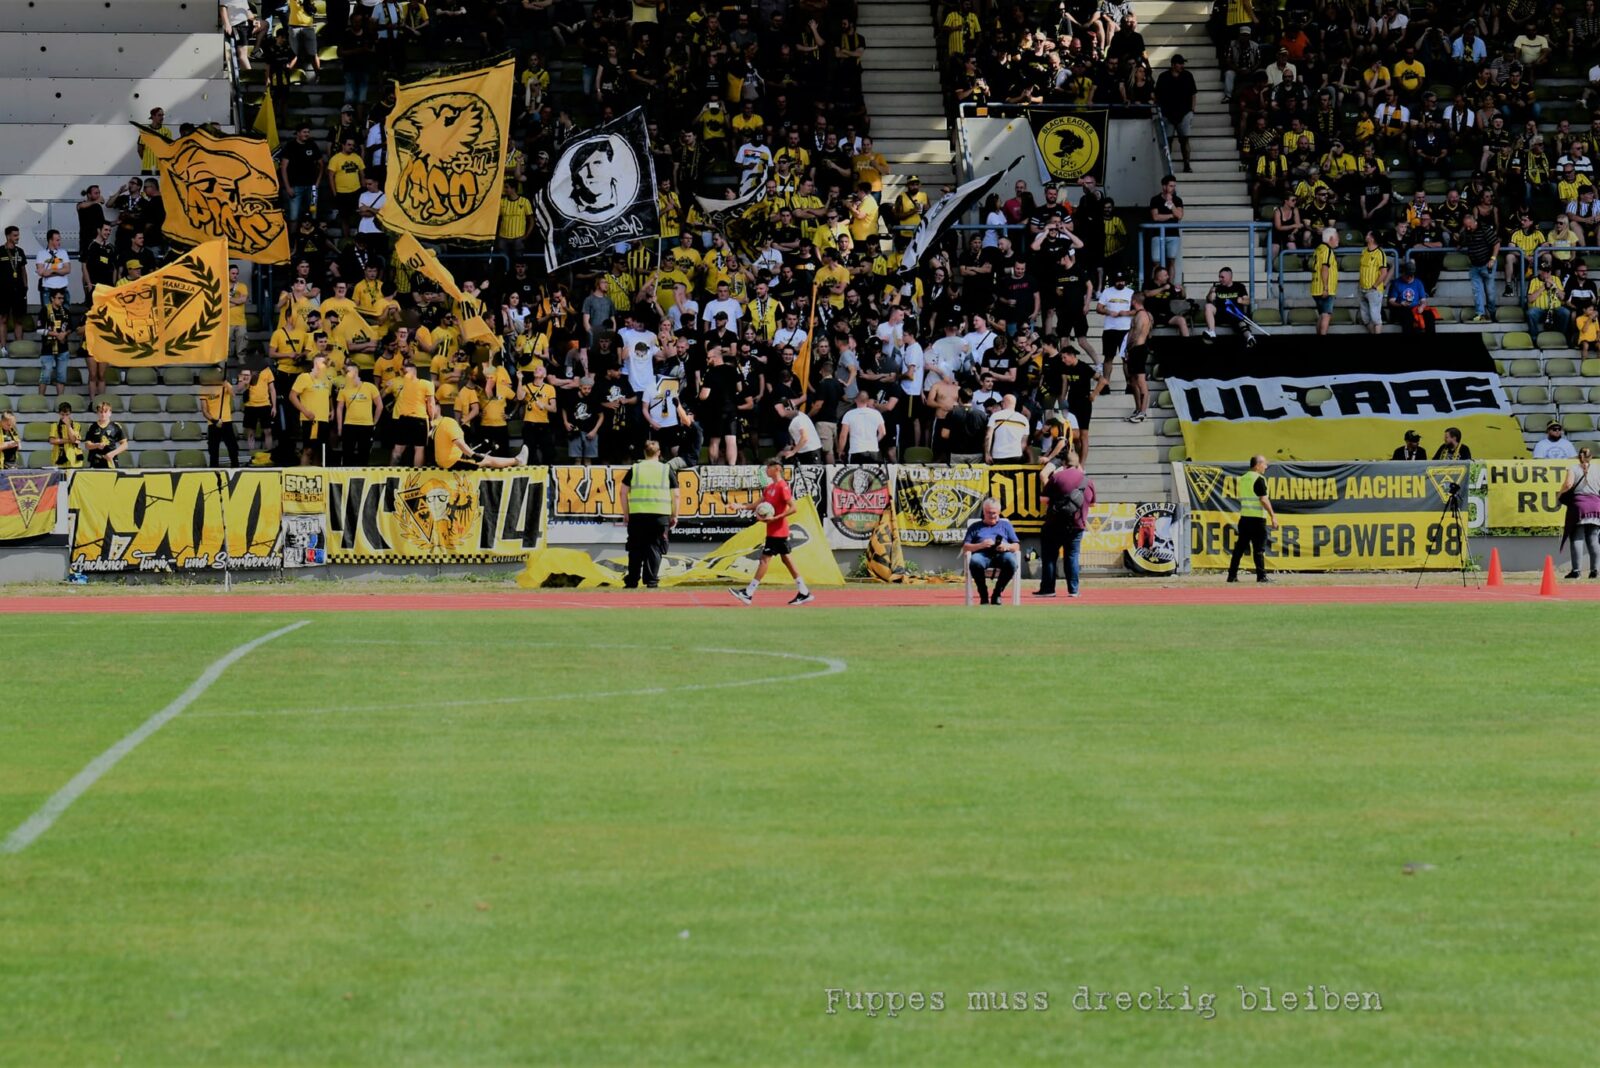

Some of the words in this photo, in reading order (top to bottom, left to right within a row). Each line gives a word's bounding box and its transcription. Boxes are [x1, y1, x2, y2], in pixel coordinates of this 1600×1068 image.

[1042, 118, 1065, 135] BLACK
[1067, 117, 1094, 135] EAGLES
[1053, 169, 1083, 178] AACHEN
[1184, 377, 1502, 421] ULTRAS
[933, 468, 983, 481] STADT
[1344, 475, 1426, 499] AACHEN
[836, 493, 887, 510] FAXE
[900, 530, 930, 542] UND
[1312, 523, 1416, 558] POWER
[1425, 523, 1462, 557] 98
[72, 553, 128, 572] Aachener
[185, 552, 209, 570] und
[213, 551, 282, 571] Sportverein
